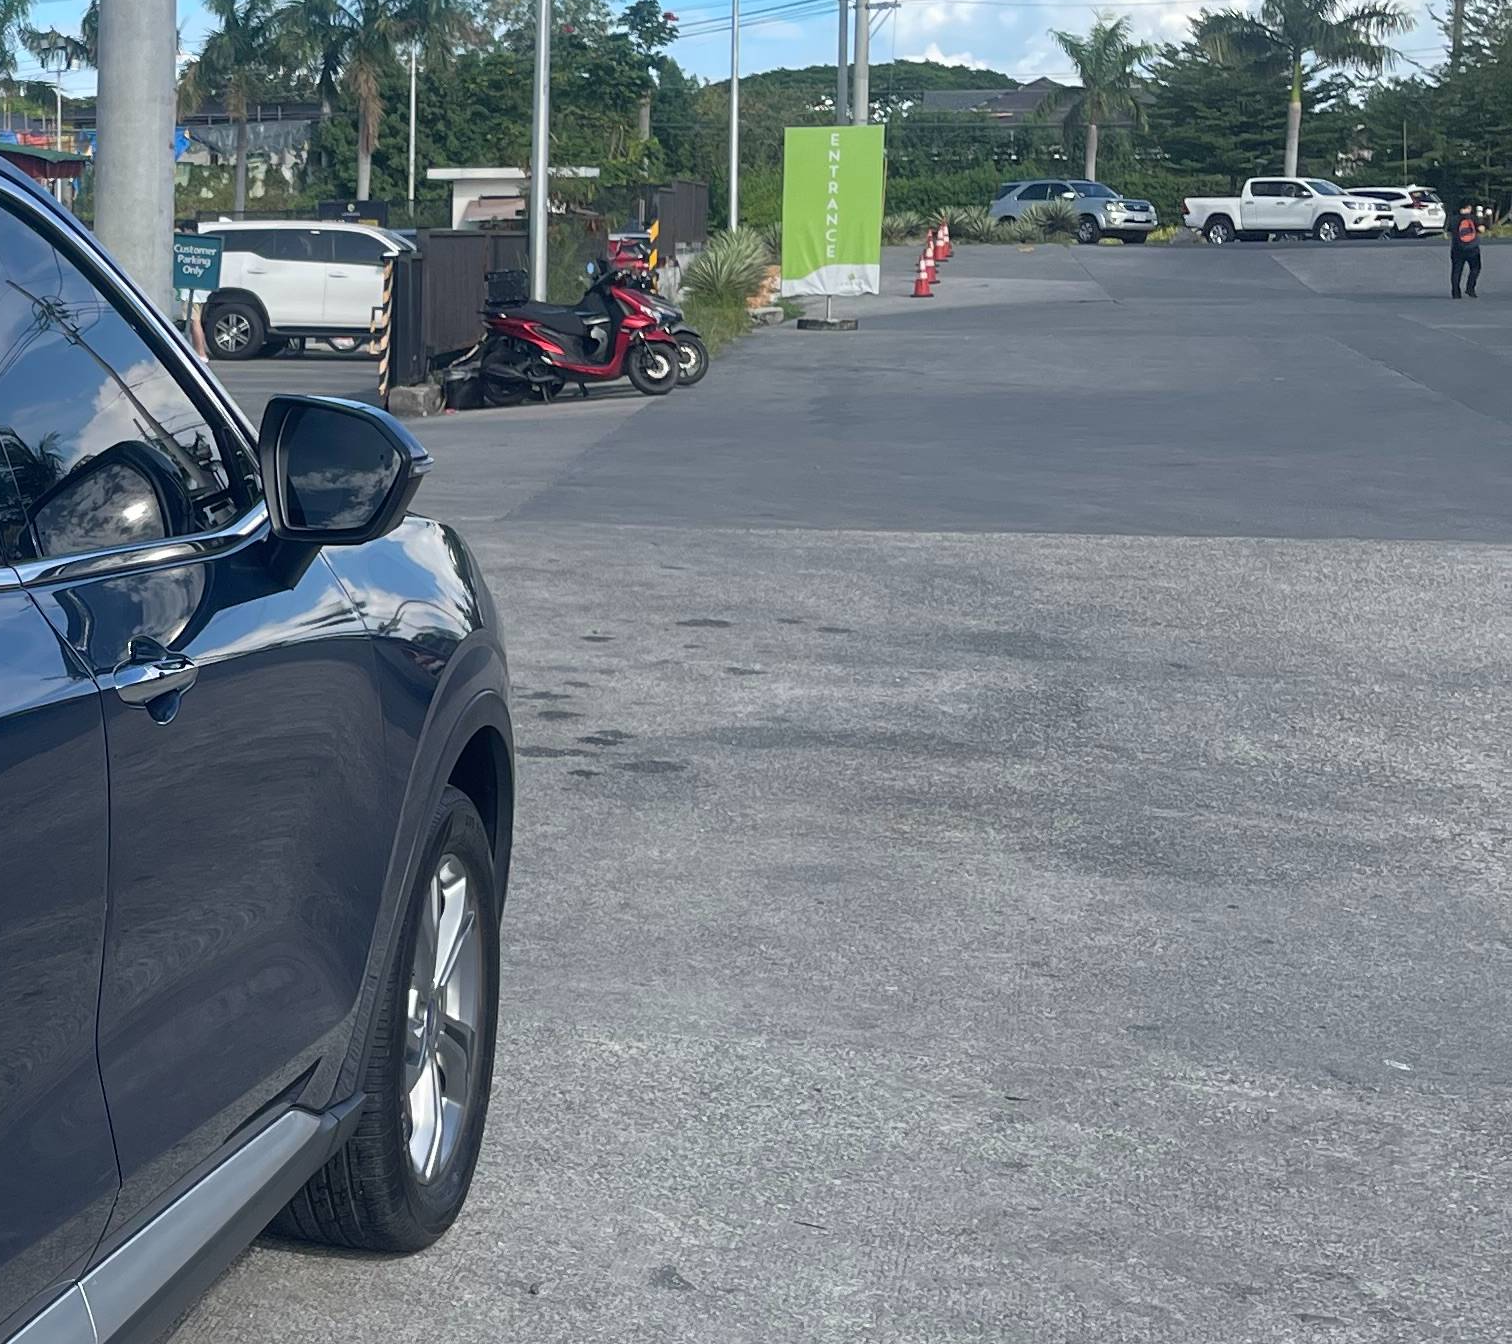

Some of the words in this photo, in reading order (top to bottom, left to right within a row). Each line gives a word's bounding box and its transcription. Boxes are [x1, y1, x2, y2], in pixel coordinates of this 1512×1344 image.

[825, 133, 840, 258] ENTRANCE
[174, 244, 217, 256] Customer
[177, 254, 211, 269] Parking
[182, 265, 204, 278] Only
